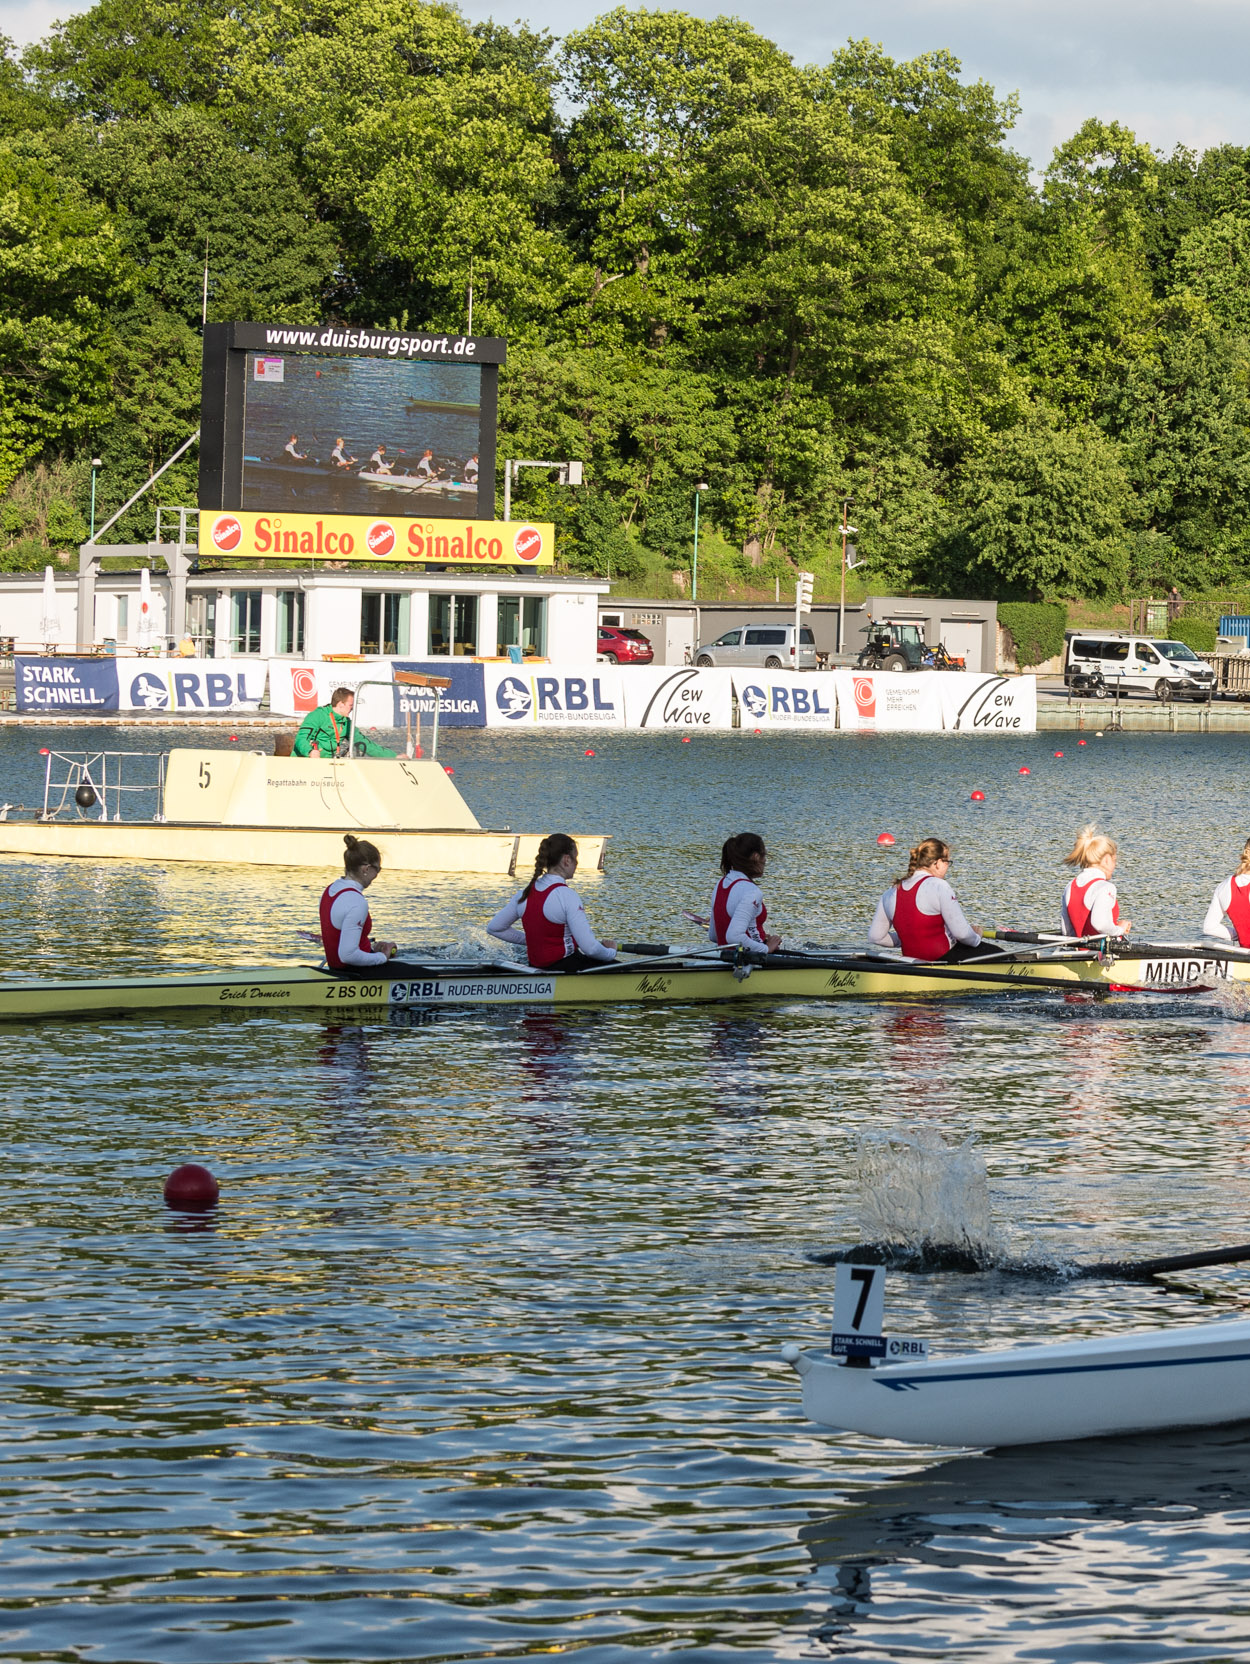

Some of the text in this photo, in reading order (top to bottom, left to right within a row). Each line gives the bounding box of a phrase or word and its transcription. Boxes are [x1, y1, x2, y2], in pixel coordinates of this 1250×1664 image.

[266, 328, 476, 356] www.duisburgsport.de
[254, 517, 355, 555] Sinalco
[407, 523, 503, 560] Sinalco
[23, 665, 81, 684] STARK.
[23, 686, 105, 704] SCHNELL.
[175, 673, 263, 707] RBL
[536, 677, 615, 711] RBL
[400, 699, 480, 713] BUNDESLIGA
[772, 686, 830, 714] RBL
[538, 712, 617, 721] RUDER-BUNDESLIGA
[199, 761, 211, 789] 5
[326, 985, 383, 998] Z BS 001
[409, 982, 553, 996] RBL RUDER-BUNDESLIGA
[635, 974, 668, 993] Melitta
[219, 987, 290, 1000] Erich Domeier
[851, 1268, 875, 1331] 7
[834, 1337, 883, 1347] STARK. SCHNELL.
[834, 1345, 848, 1353] GUT.
[902, 1342, 926, 1354] RBL
